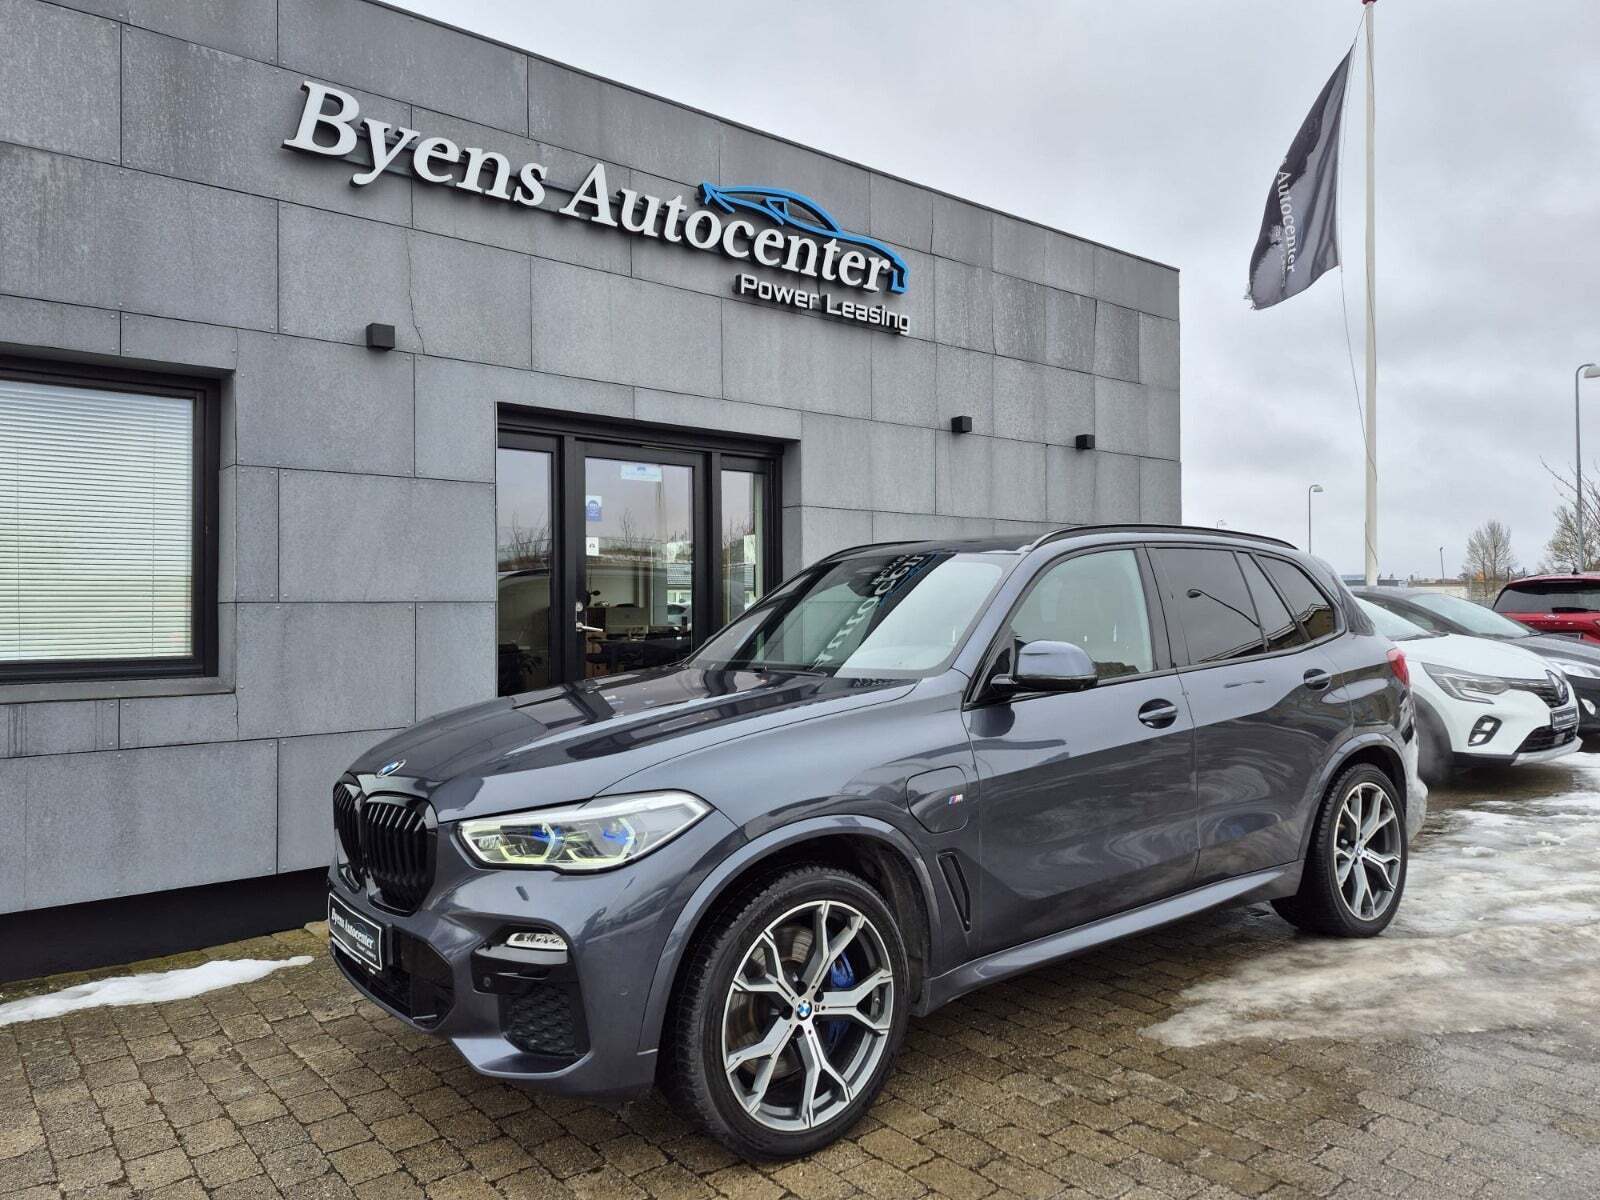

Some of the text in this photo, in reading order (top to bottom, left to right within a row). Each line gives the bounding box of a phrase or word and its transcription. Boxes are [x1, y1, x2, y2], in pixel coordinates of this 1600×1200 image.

[284, 80, 892, 292] Byens Autocenter
[1278, 171, 1296, 272] Autocenter
[740, 273, 910, 335] Power Leasing
